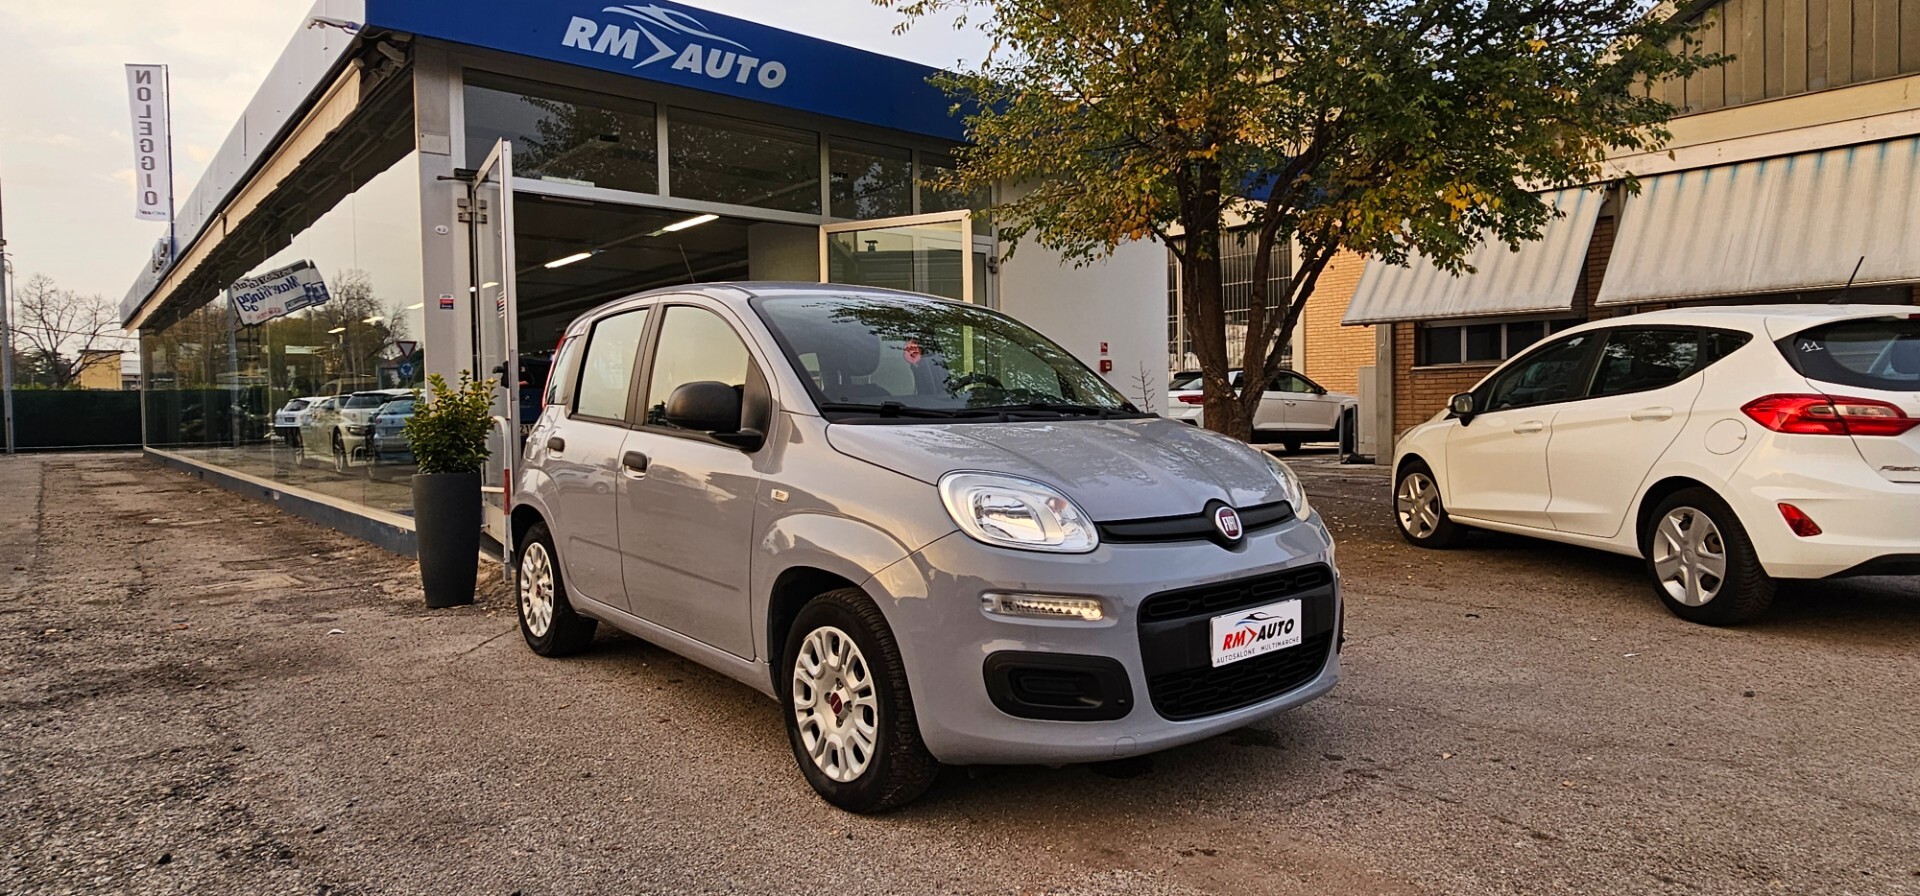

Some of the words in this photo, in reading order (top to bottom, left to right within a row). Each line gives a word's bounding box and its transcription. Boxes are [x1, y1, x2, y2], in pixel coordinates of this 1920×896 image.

[562, 16, 639, 60] RM
[671, 43, 787, 89] AUTO
[1801, 341, 1823, 352] 11
[1221, 516, 1238, 532] FIAT
[1222, 630, 1246, 651] RM
[1256, 618, 1295, 643] AUTO
[1216, 647, 1255, 664] AUTOSALONE
[1260, 635, 1300, 651] MULTIMARCHE
